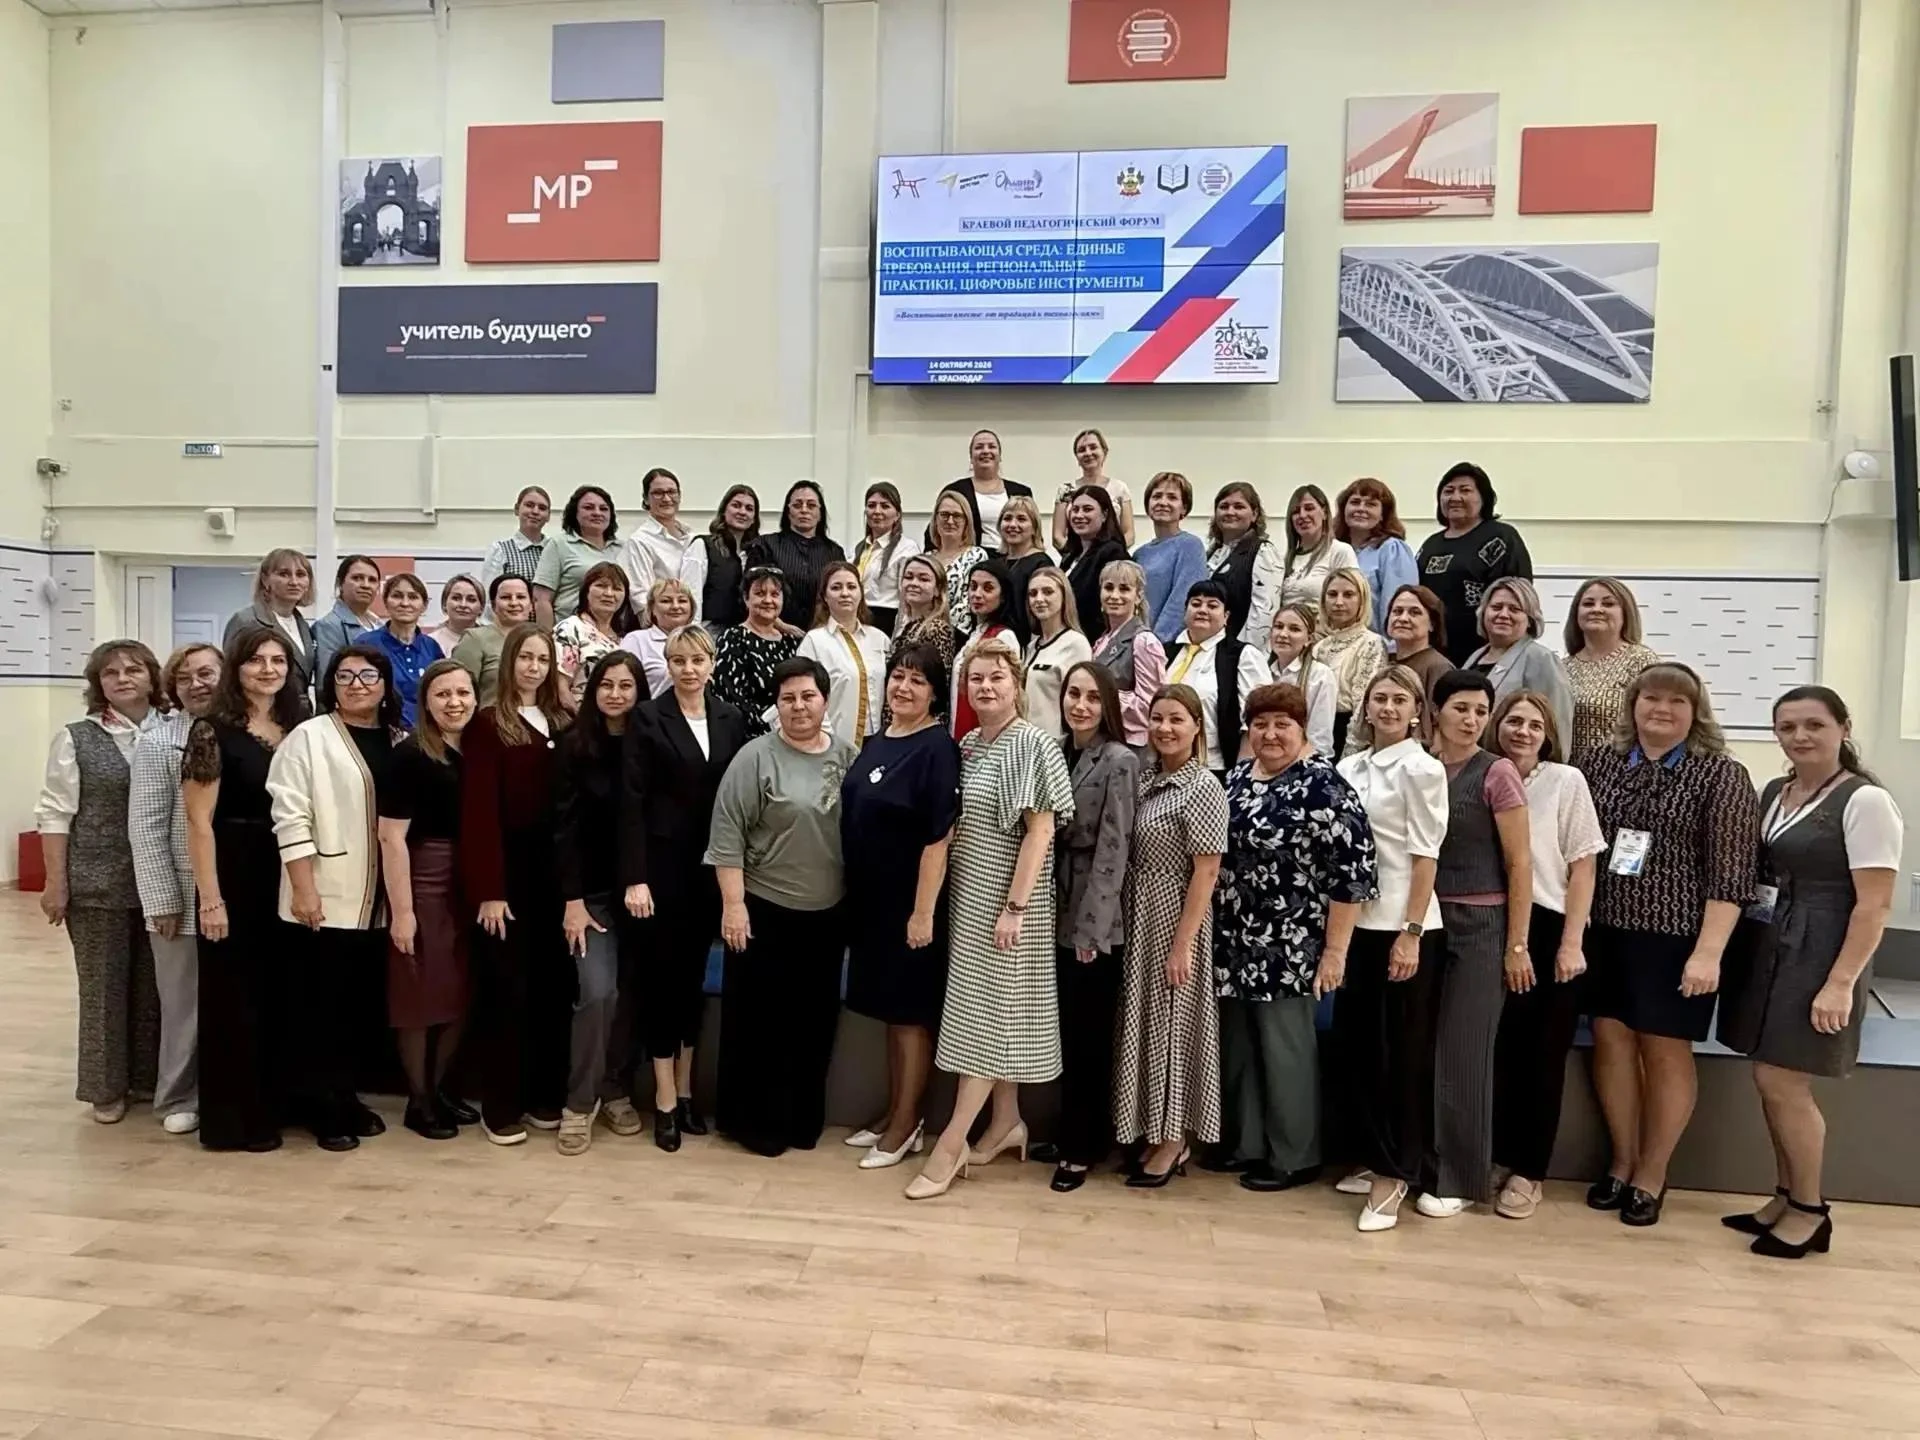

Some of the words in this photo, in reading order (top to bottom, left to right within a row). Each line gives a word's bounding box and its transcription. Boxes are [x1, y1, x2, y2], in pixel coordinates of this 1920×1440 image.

[962, 218, 1011, 229] КРАЕВОЙ
[1014, 216, 1117, 229] ПЕДАГОГИЧЕСКИЙ
[1119, 216, 1160, 227] ФОРУМ
[883, 245, 1013, 257] ВОСПИТЫВАЮЩАЯ
[1016, 244, 1063, 256] СРЕДА:
[1066, 243, 1125, 255] ЕДИНЫЕ
[882, 262, 974, 275] ТРЕБОВАНИЯ,
[976, 260, 1086, 273] РЕГИОНАЛЬНЫЕ
[882, 278, 958, 292] ПРАКТИКИ,
[960, 278, 1037, 291] ЦИФРОВЫЕ
[1039, 277, 1144, 289] ИНСТРУМЕНТЫ
[400, 324, 484, 345] учитель
[488, 318, 593, 345] будущего
[929, 361, 939, 370] 14
[939, 361, 974, 369] ОКТЯБРЯ
[938, 374, 984, 383] КРАСНОДАР
